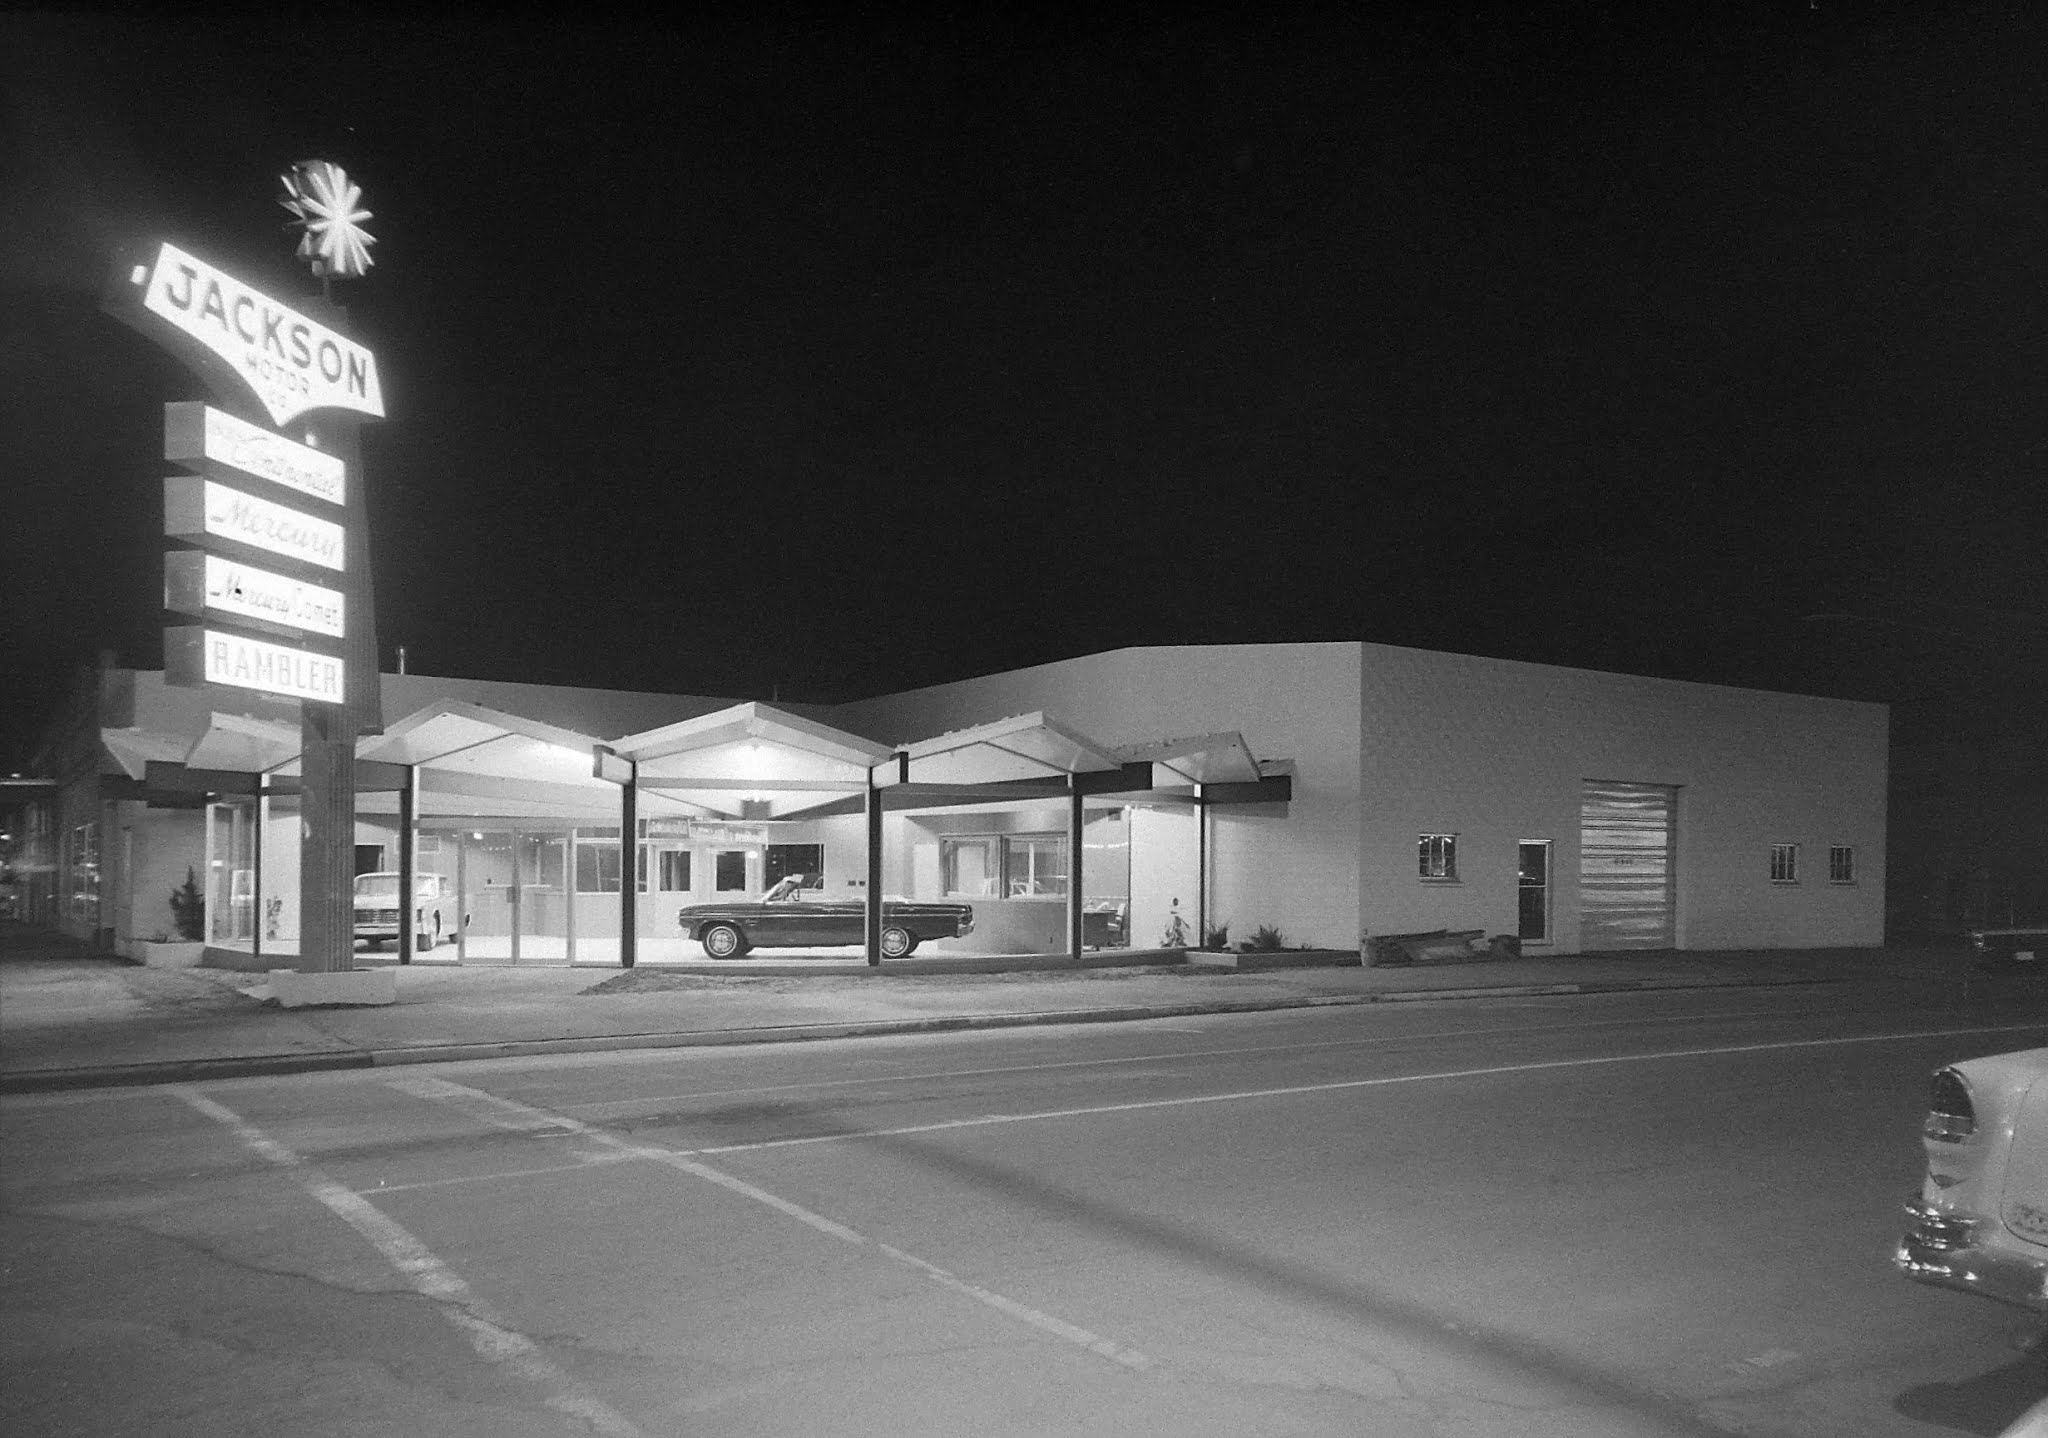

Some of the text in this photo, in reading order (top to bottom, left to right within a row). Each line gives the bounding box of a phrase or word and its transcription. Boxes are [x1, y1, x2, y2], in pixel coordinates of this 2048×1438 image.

[165, 263, 367, 398] JACKSON
[246, 351, 309, 395] MOTOR
[210, 498, 337, 561] Mercury
[209, 571, 290, 619] Mercury
[213, 641, 337, 694] RAMBLER
